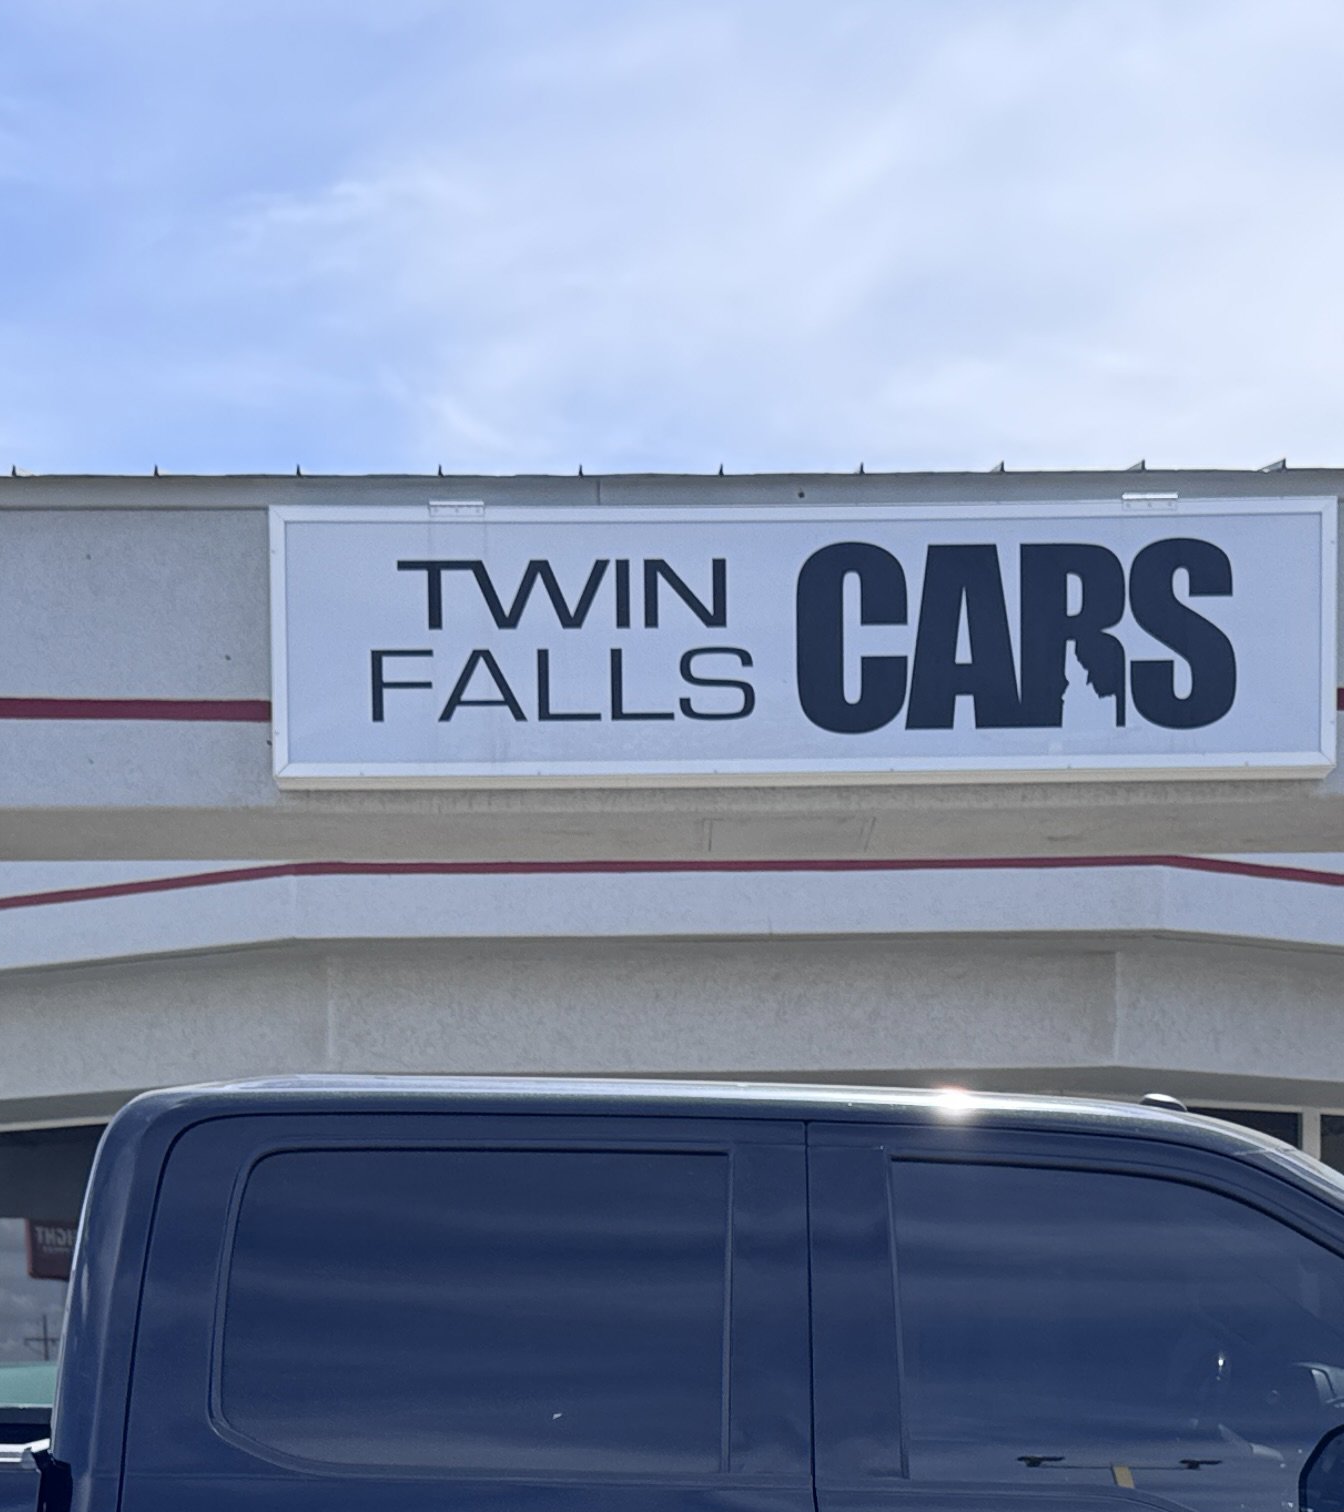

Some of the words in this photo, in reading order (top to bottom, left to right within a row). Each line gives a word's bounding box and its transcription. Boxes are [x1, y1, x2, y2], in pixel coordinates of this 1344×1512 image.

[396, 557, 728, 630] TWIN
[794, 536, 1237, 734] CARS
[370, 646, 755, 723] FALLS
